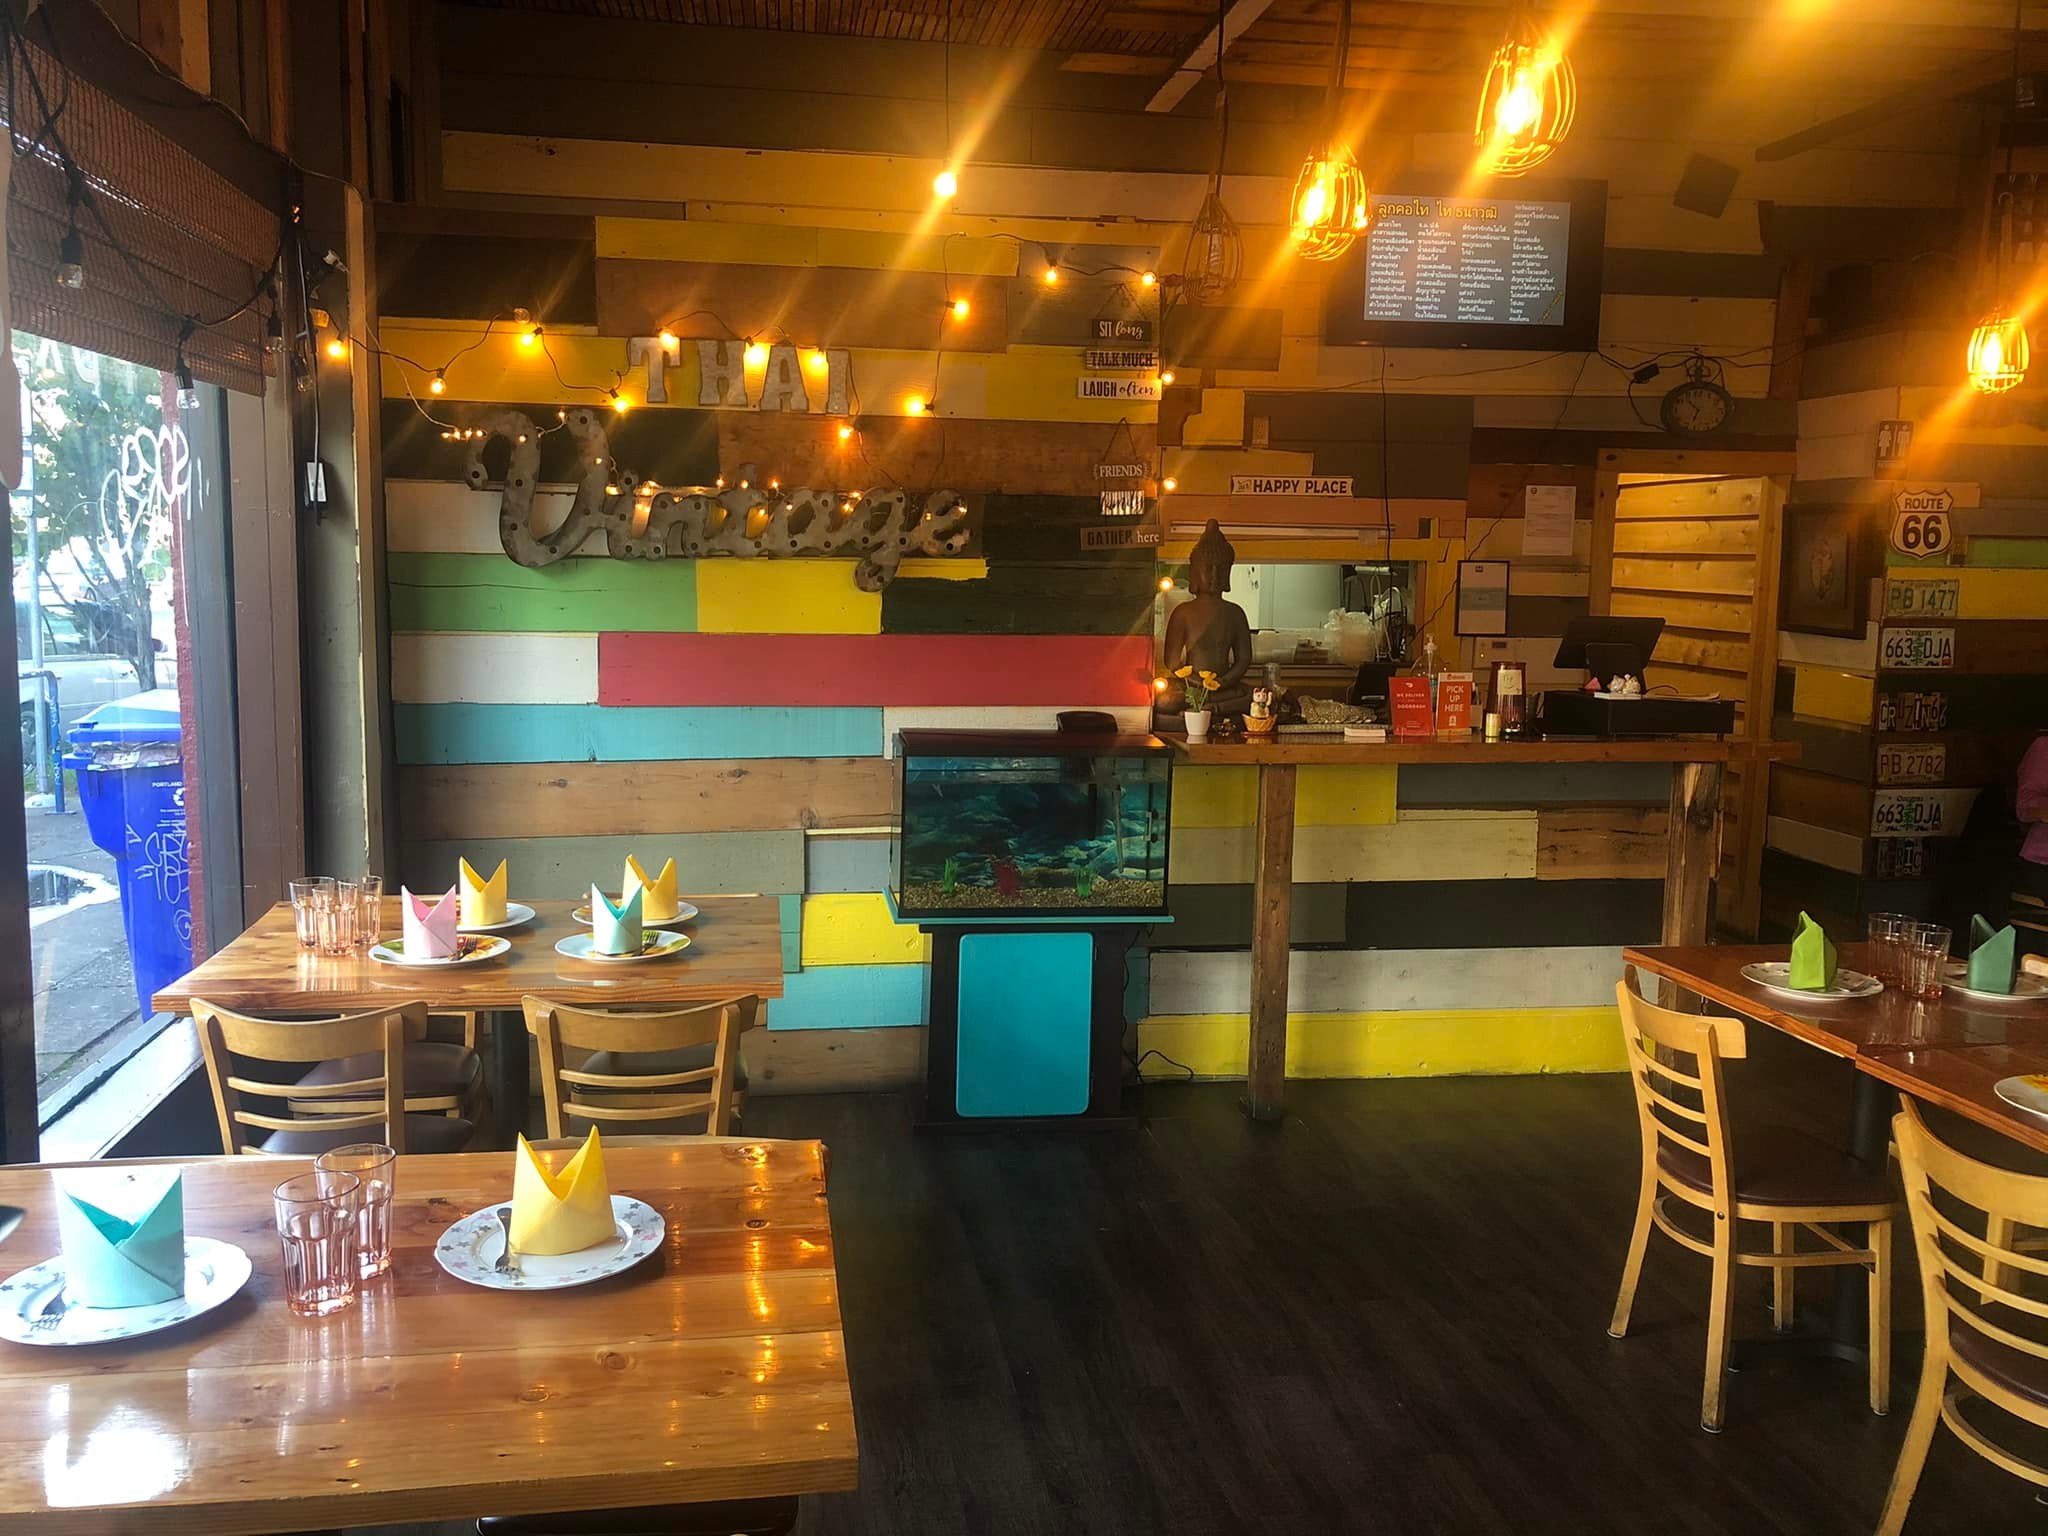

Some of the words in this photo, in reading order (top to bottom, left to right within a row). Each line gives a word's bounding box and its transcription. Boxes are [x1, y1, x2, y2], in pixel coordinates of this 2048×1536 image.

[1099, 320, 1112, 337] SIT
[1115, 320, 1143, 339] long
[1090, 352, 1120, 366] TALK
[1122, 352, 1152, 367] MUCH
[630, 336, 849, 414] THAI
[1083, 381, 1117, 397] LAUGH
[1119, 381, 1155, 397] often
[1099, 464, 1143, 478] FRIENDS
[1253, 480, 1300, 493] HAPPY
[1305, 480, 1347, 493] PLACE
[465, 408, 970, 592] Vintage
[1904, 497, 1944, 510] ROUTE
[1087, 530, 1133, 545] GATHER
[1136, 531, 1159, 543] here
[1902, 515, 1942, 550] 66
[1921, 589, 1955, 610] 1477
[1885, 637, 1913, 658] 663
[1924, 637, 1952, 658] DJA
[1447, 685, 1464, 694] PICK
[1449, 695, 1461, 703] UP
[1444, 704, 1464, 712] HERE
[1906, 755, 1944, 775] 2782
[1876, 804, 1905, 824] 663
[1914, 803, 1942, 824] DJA
